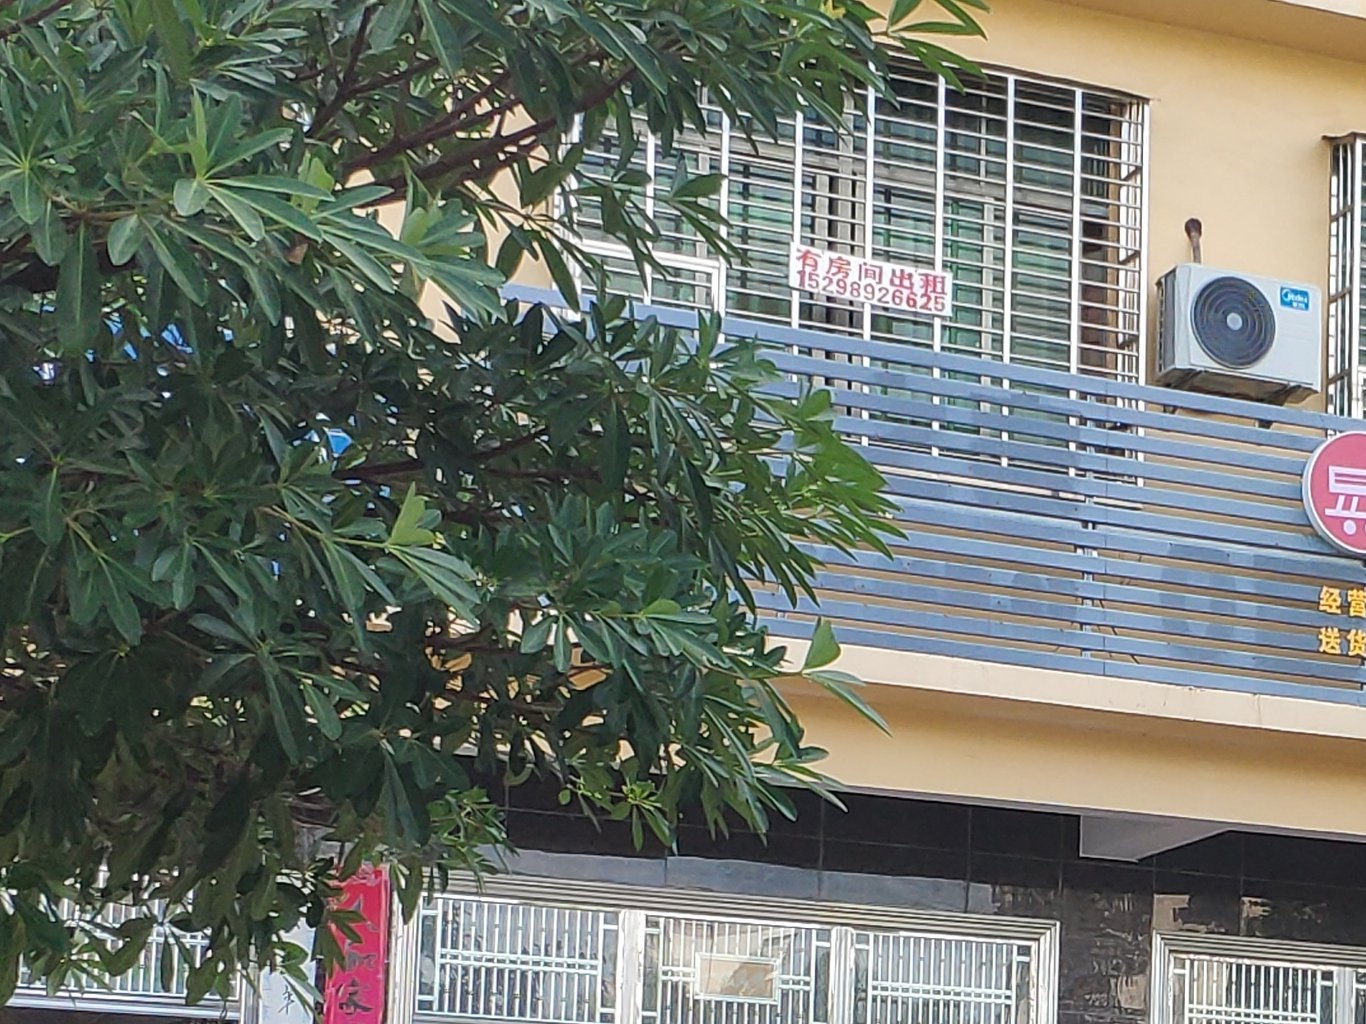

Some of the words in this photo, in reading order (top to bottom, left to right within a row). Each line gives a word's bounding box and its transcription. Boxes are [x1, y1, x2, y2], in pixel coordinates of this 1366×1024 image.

[796, 249, 947, 295] 有房间出租
[796, 270, 945, 312] 15298926625
